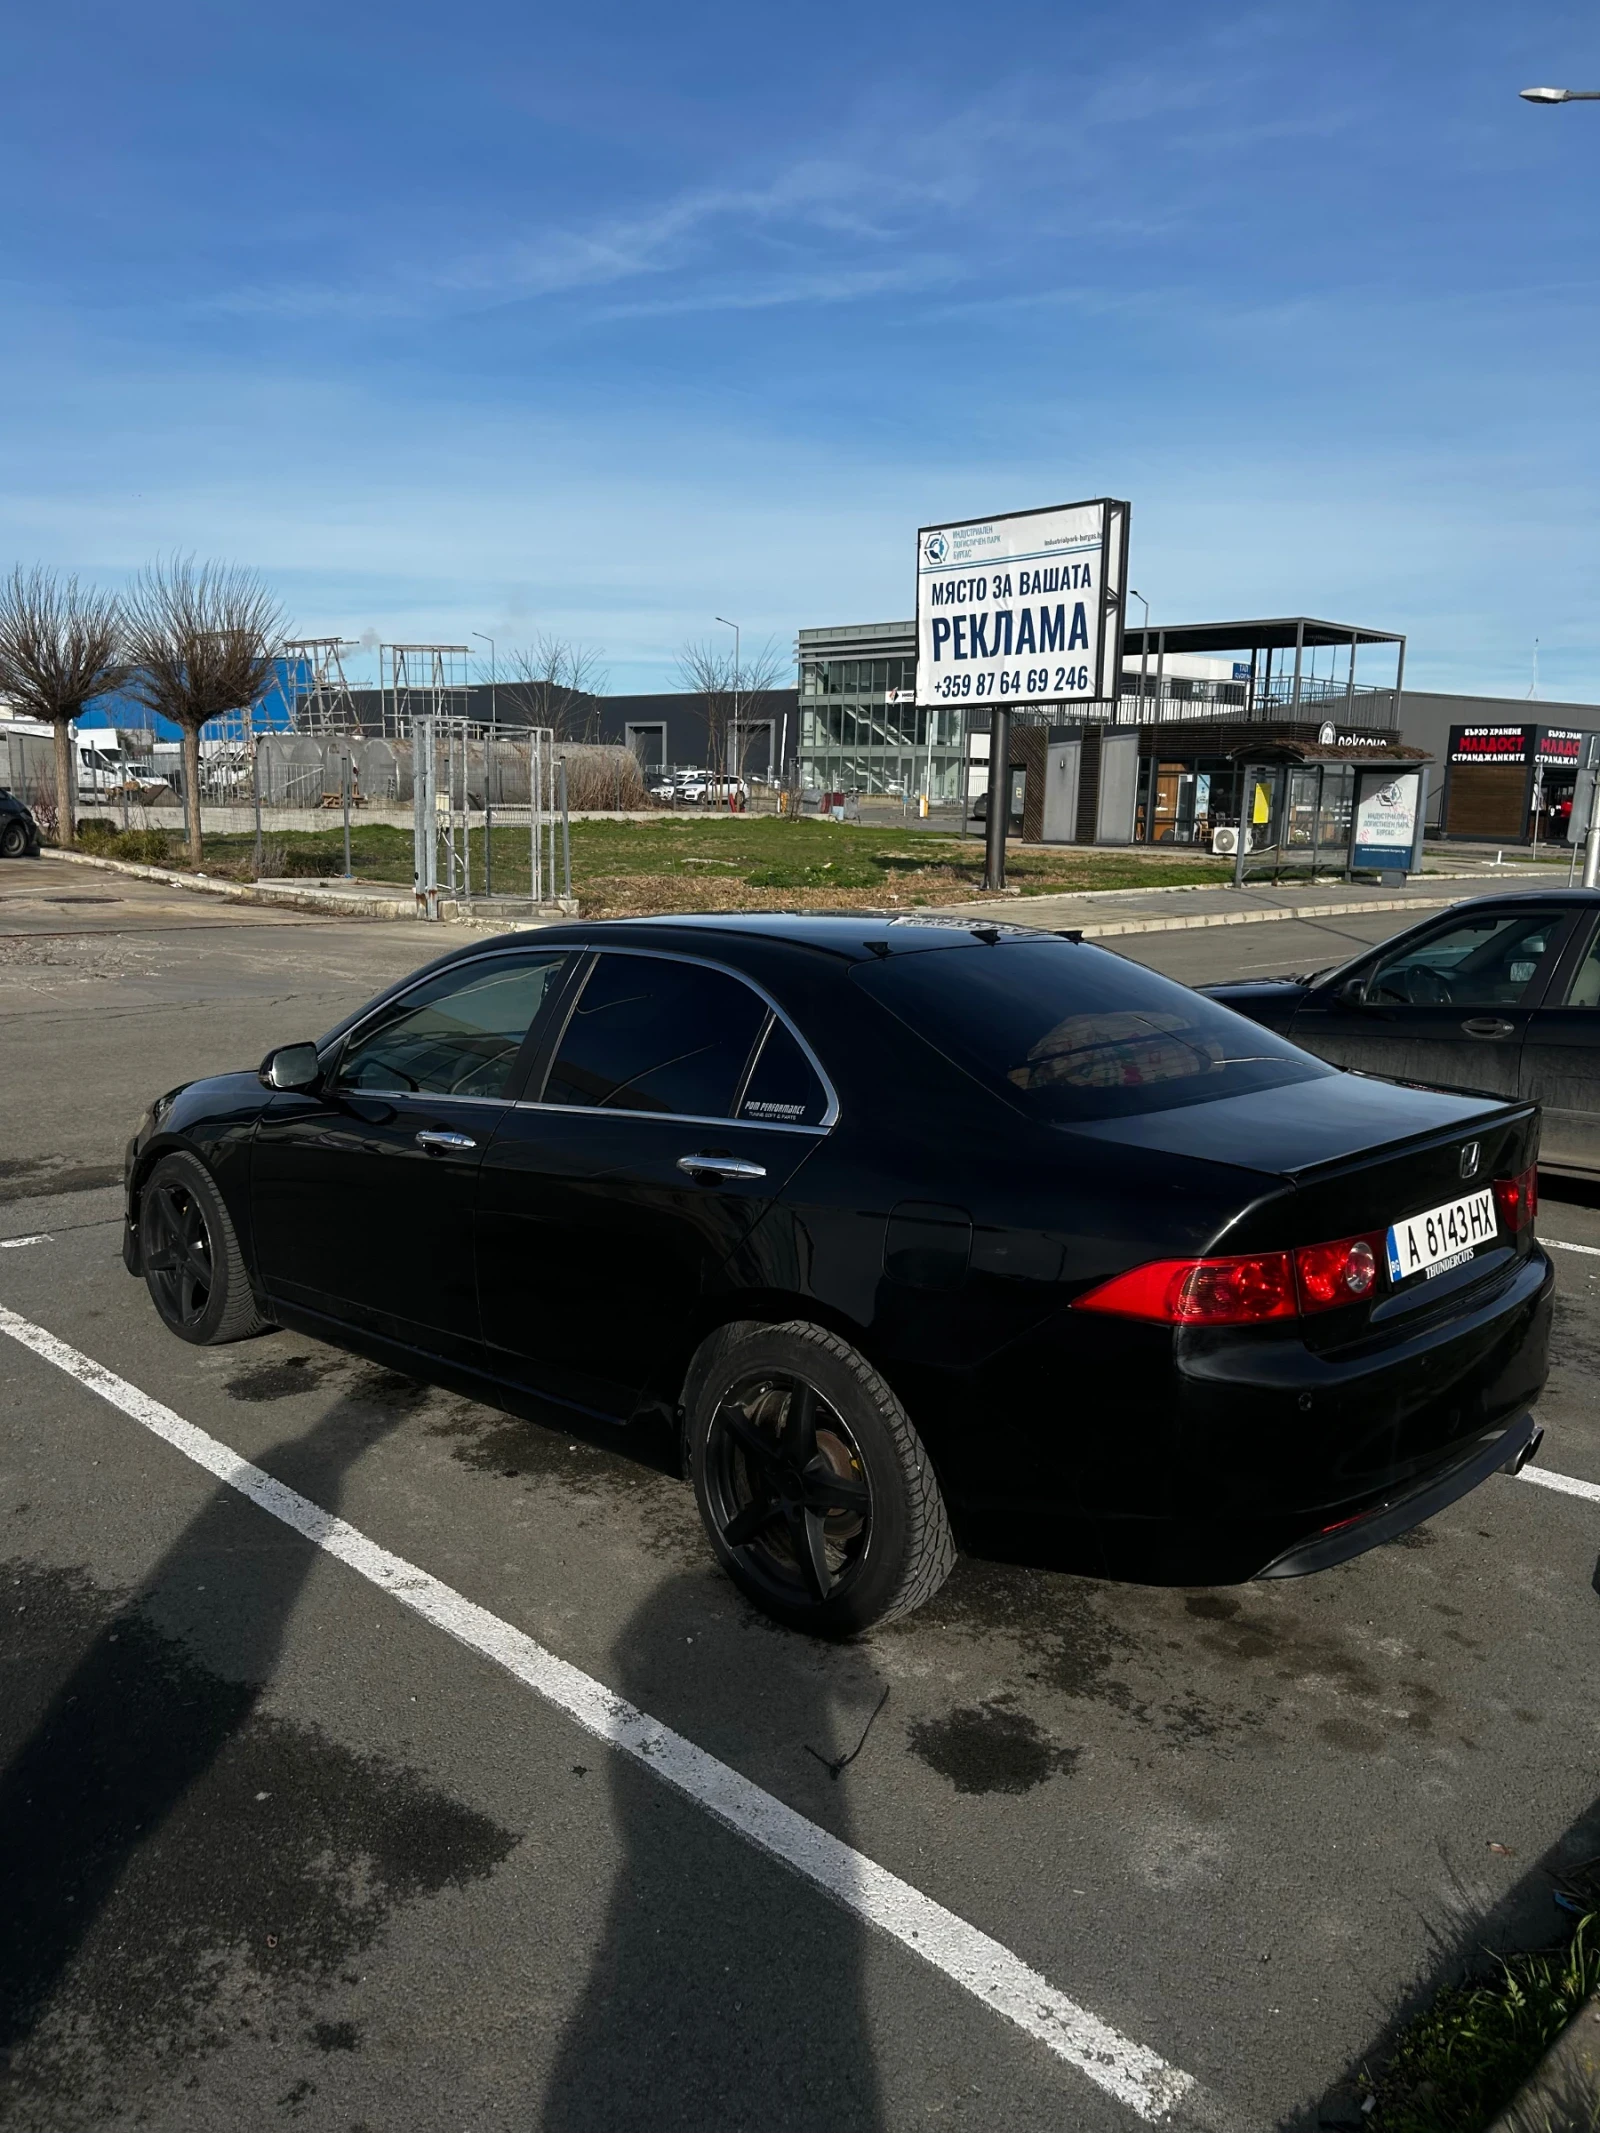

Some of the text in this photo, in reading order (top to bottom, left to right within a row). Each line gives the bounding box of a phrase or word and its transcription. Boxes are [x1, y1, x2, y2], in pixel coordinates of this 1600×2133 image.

[952, 525, 993, 539] ИНДУСТРИАЛЕН
[953, 535, 1001, 549] ЛОГИСТИЧЕН ПАРК
[953, 549, 972, 560] БУРГАС
[931, 563, 1092, 606] МЯСТО ЗА ВАШАТА
[931, 601, 1089, 662] РЕКЛАМА
[934, 665, 1088, 698] +359 87 64 69 246
[1464, 728, 1488, 736] БЪРЗО
[1548, 729, 1566, 739] БЪРЗО
[1459, 736, 1525, 752] МЛАДОСТ
[1451, 753, 1526, 762] СТРАНДЖАНКИТЕ
[1425, 1247, 1474, 1280] THUNDERCUTS
